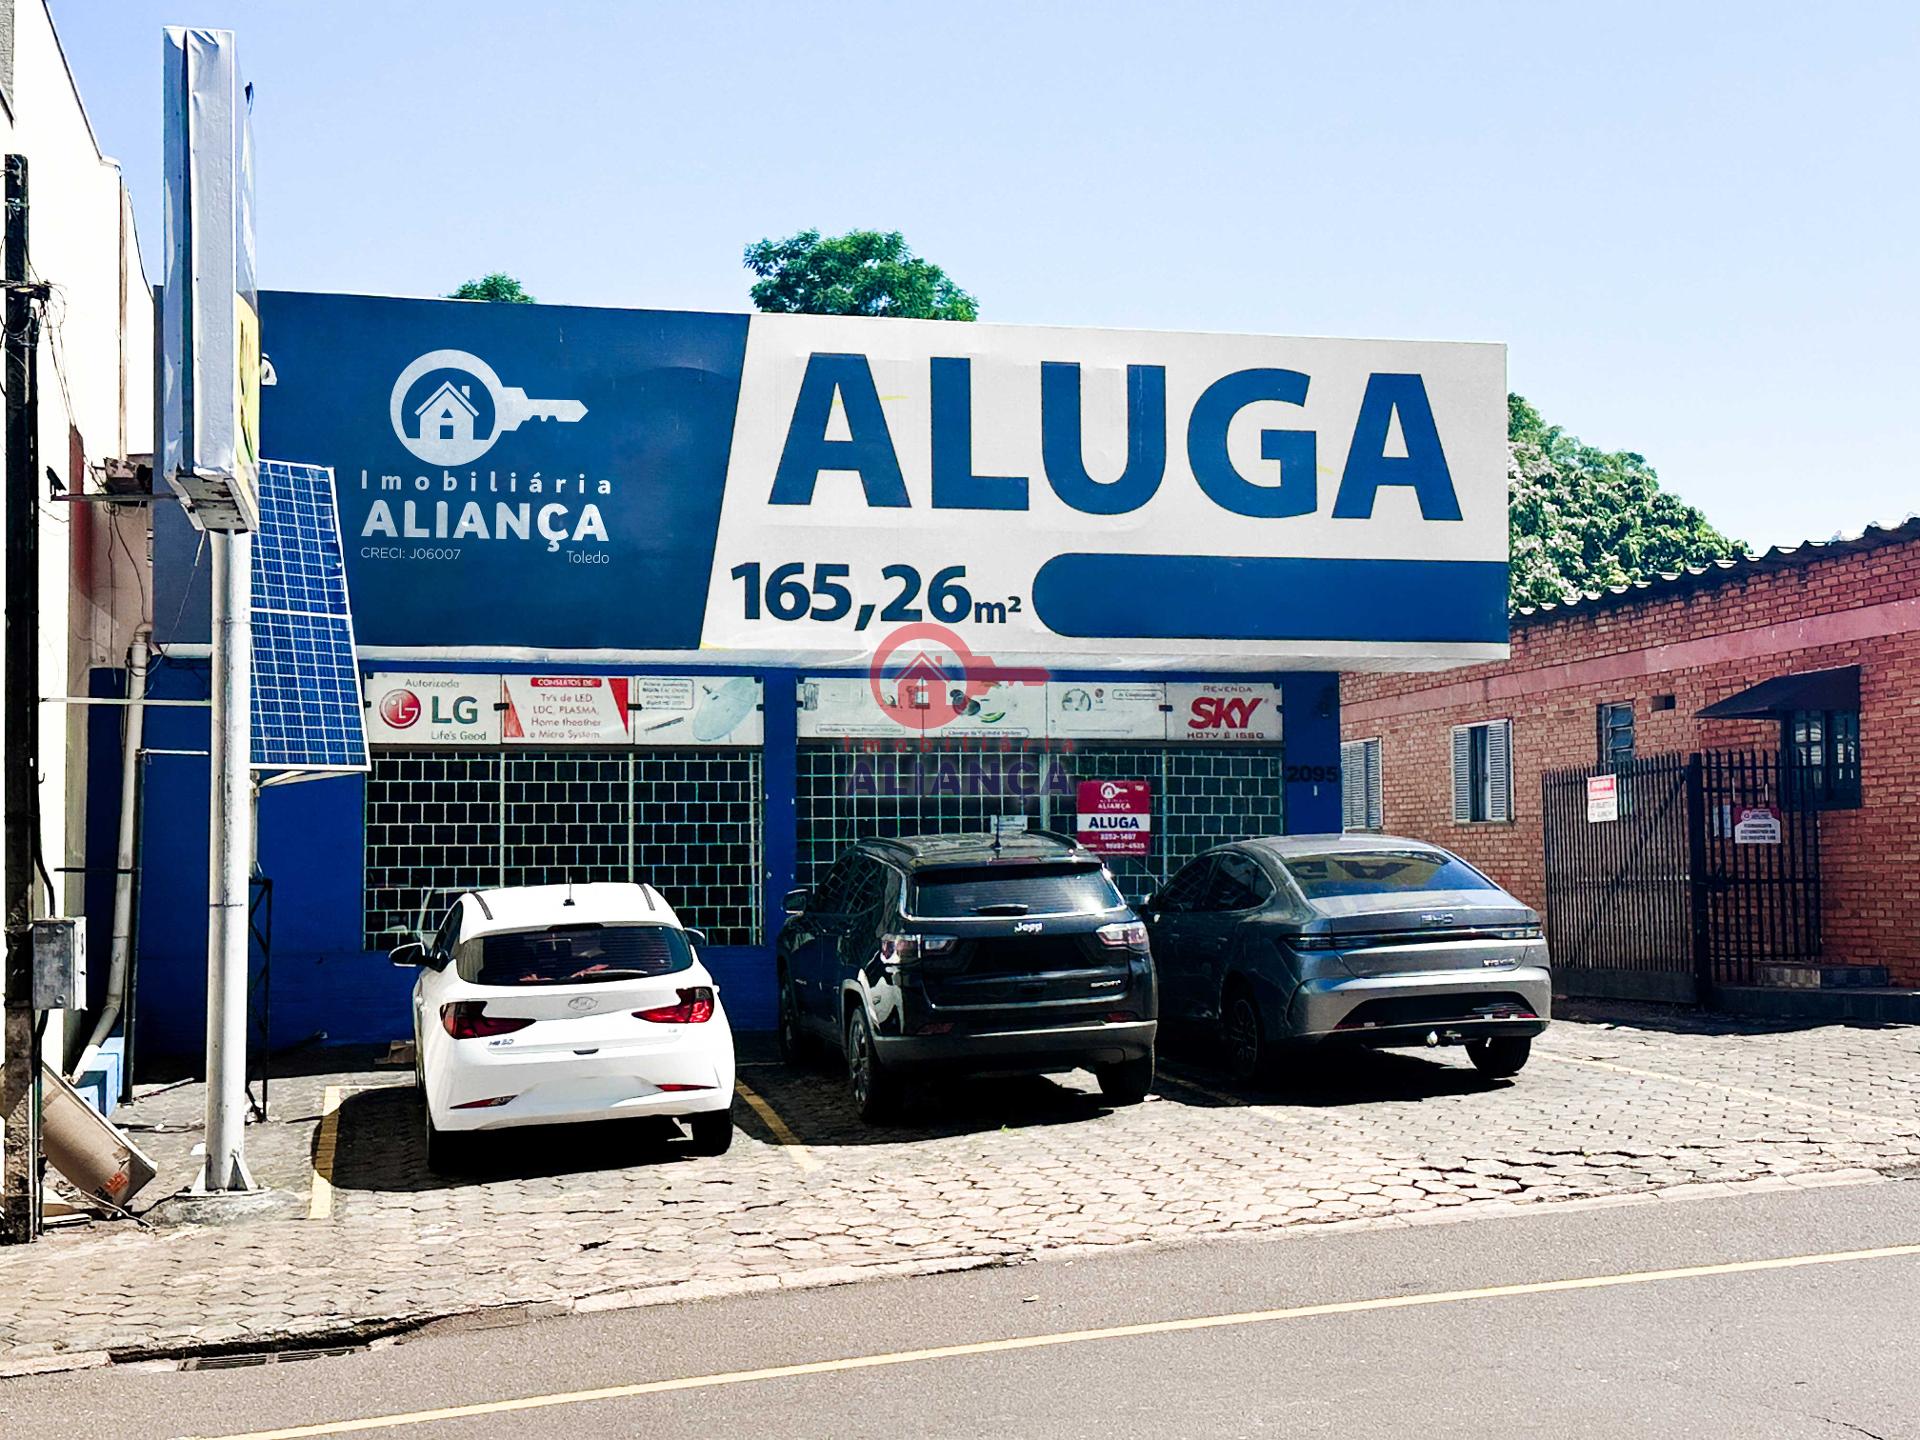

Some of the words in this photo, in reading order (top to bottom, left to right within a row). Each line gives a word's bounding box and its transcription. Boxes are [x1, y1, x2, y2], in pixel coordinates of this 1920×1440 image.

[767, 351, 1464, 521] ALUGA
[361, 470, 612, 495] Imobiliária
[360, 499, 610, 552] ALIANÇA
[360, 547, 406, 559] CRECI:
[409, 548, 461, 560] J06007
[566, 550, 610, 564] Toledo
[560, 693, 572, 702] de
[431, 695, 478, 724] LG
[1188, 697, 1263, 729] SKY
[531, 717, 560, 727] Home
[460, 730, 487, 741] Good
[1287, 765, 1338, 783] 2095
[1089, 817, 1139, 829] ALUGA
